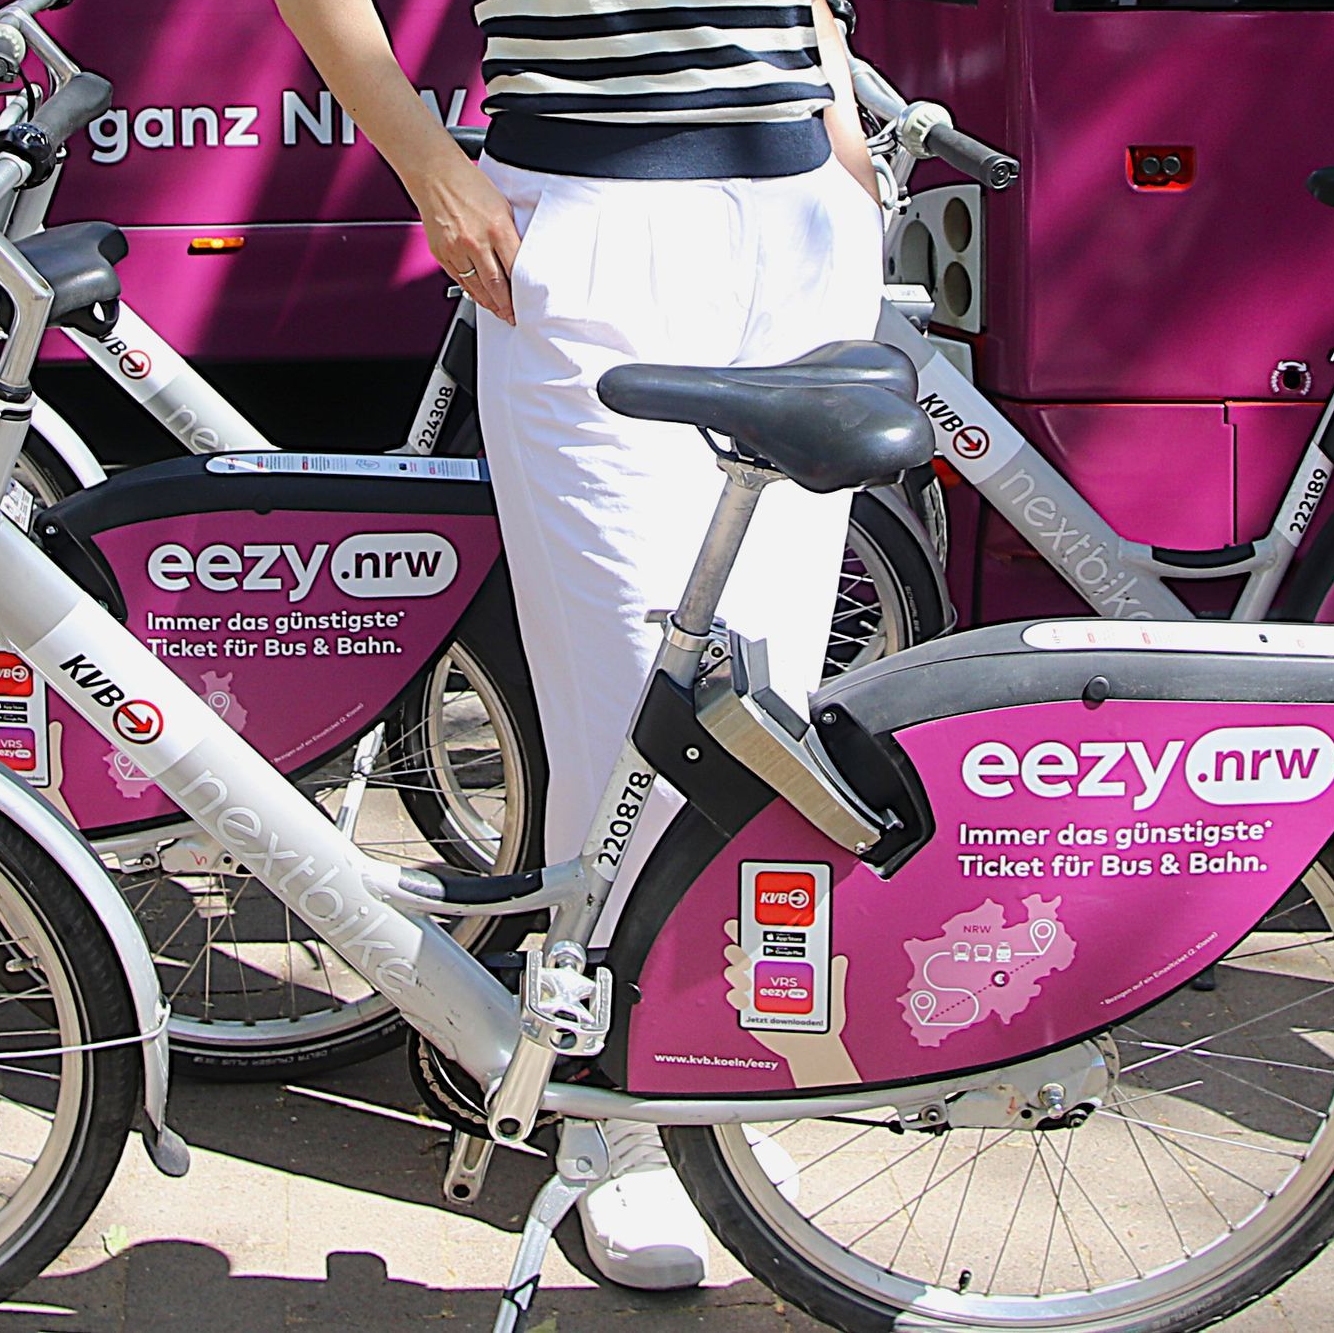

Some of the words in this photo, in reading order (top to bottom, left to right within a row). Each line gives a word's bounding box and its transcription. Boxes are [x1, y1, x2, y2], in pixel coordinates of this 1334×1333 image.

[88, 103, 260, 165] ganz
[97, 331, 128, 356] VB
[417, 384, 456, 451] 224308
[918, 392, 964, 433] KVB
[1289, 468, 1329, 534] 222189
[146, 534, 443, 601] eezy.nrw
[145, 612, 221, 633] Immer
[226, 611, 269, 632] das
[146, 637, 219, 658] Ticket
[223, 635, 259, 657] für
[264, 637, 307, 657] Bus
[313, 637, 330, 656] &
[335, 635, 403, 657] Bahn.
[58, 652, 126, 709] KVB
[0, 738, 23, 748] VRS
[960, 730, 1320, 811] eezy.nrw
[598, 770, 654, 870] 220878
[957, 822, 1049, 847] Immer
[1055, 820, 1110, 845] das
[957, 852, 1048, 878] Ticket
[1051, 852, 1095, 878] für
[1102, 853, 1155, 877] Bus
[1160, 852, 1180, 877] &
[1188, 850, 1268, 876] Bahn.
[179, 765, 422, 997] nextbike
[759, 891, 788, 905] KVB
[962, 924, 992, 934] NRW
[770, 976, 799, 988] VRS
[745, 1015, 769, 1025] Jetzt
[769, 1017, 825, 1028] downloaden!
[653, 1052, 780, 1072] www.kvb.koeln/eezy
